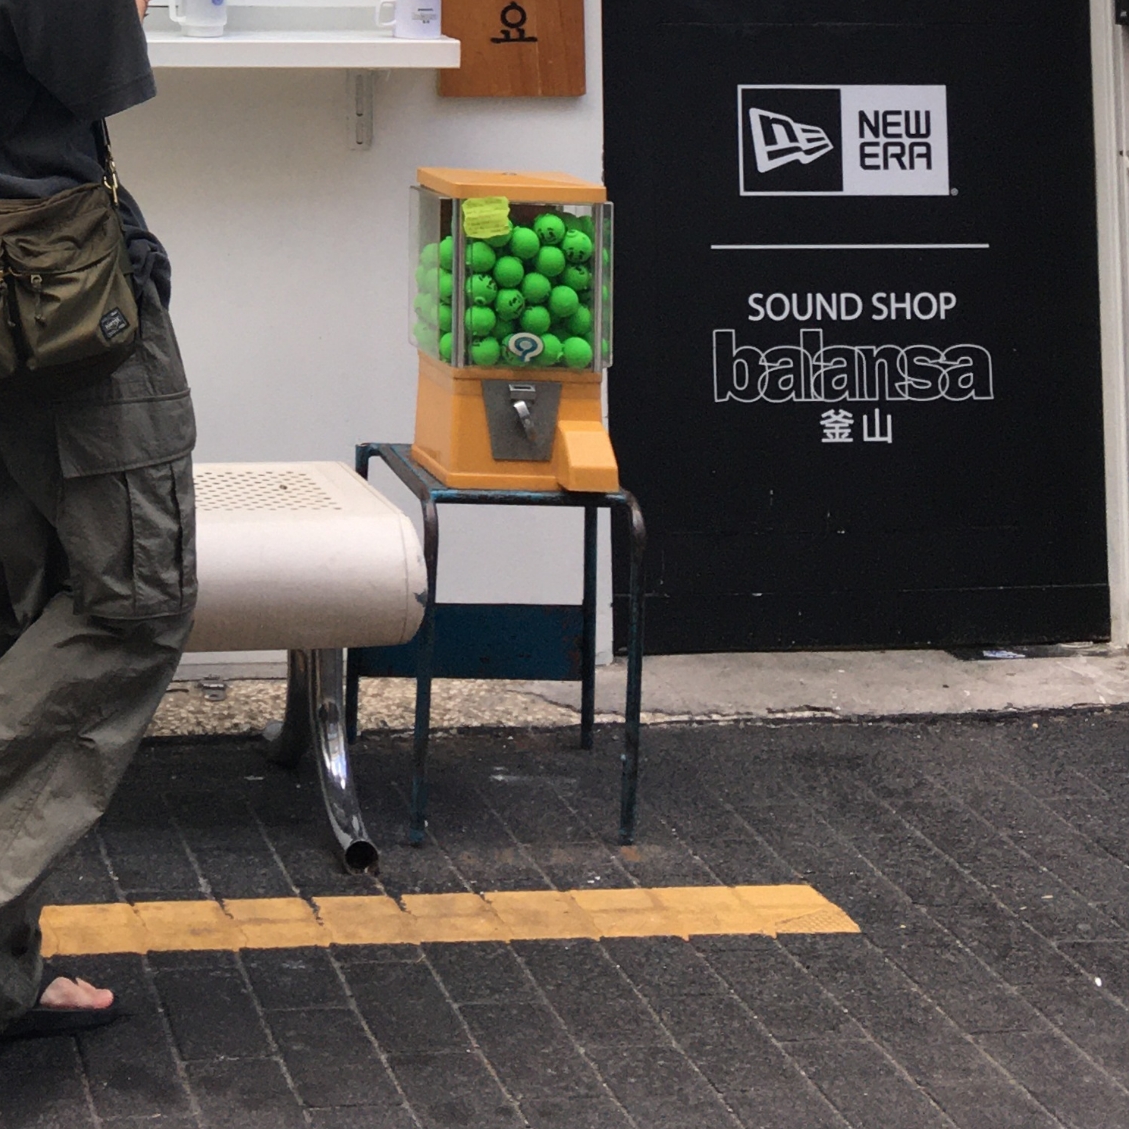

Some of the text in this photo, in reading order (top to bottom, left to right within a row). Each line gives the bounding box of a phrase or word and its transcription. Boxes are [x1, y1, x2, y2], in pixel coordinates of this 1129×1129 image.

[858, 109, 931, 139] NEW
[859, 141, 933, 171] ERA
[747, 292, 957, 321] SOUND SHOP
[713, 328, 995, 403] balansa
[820, 407, 893, 444] 釜山
